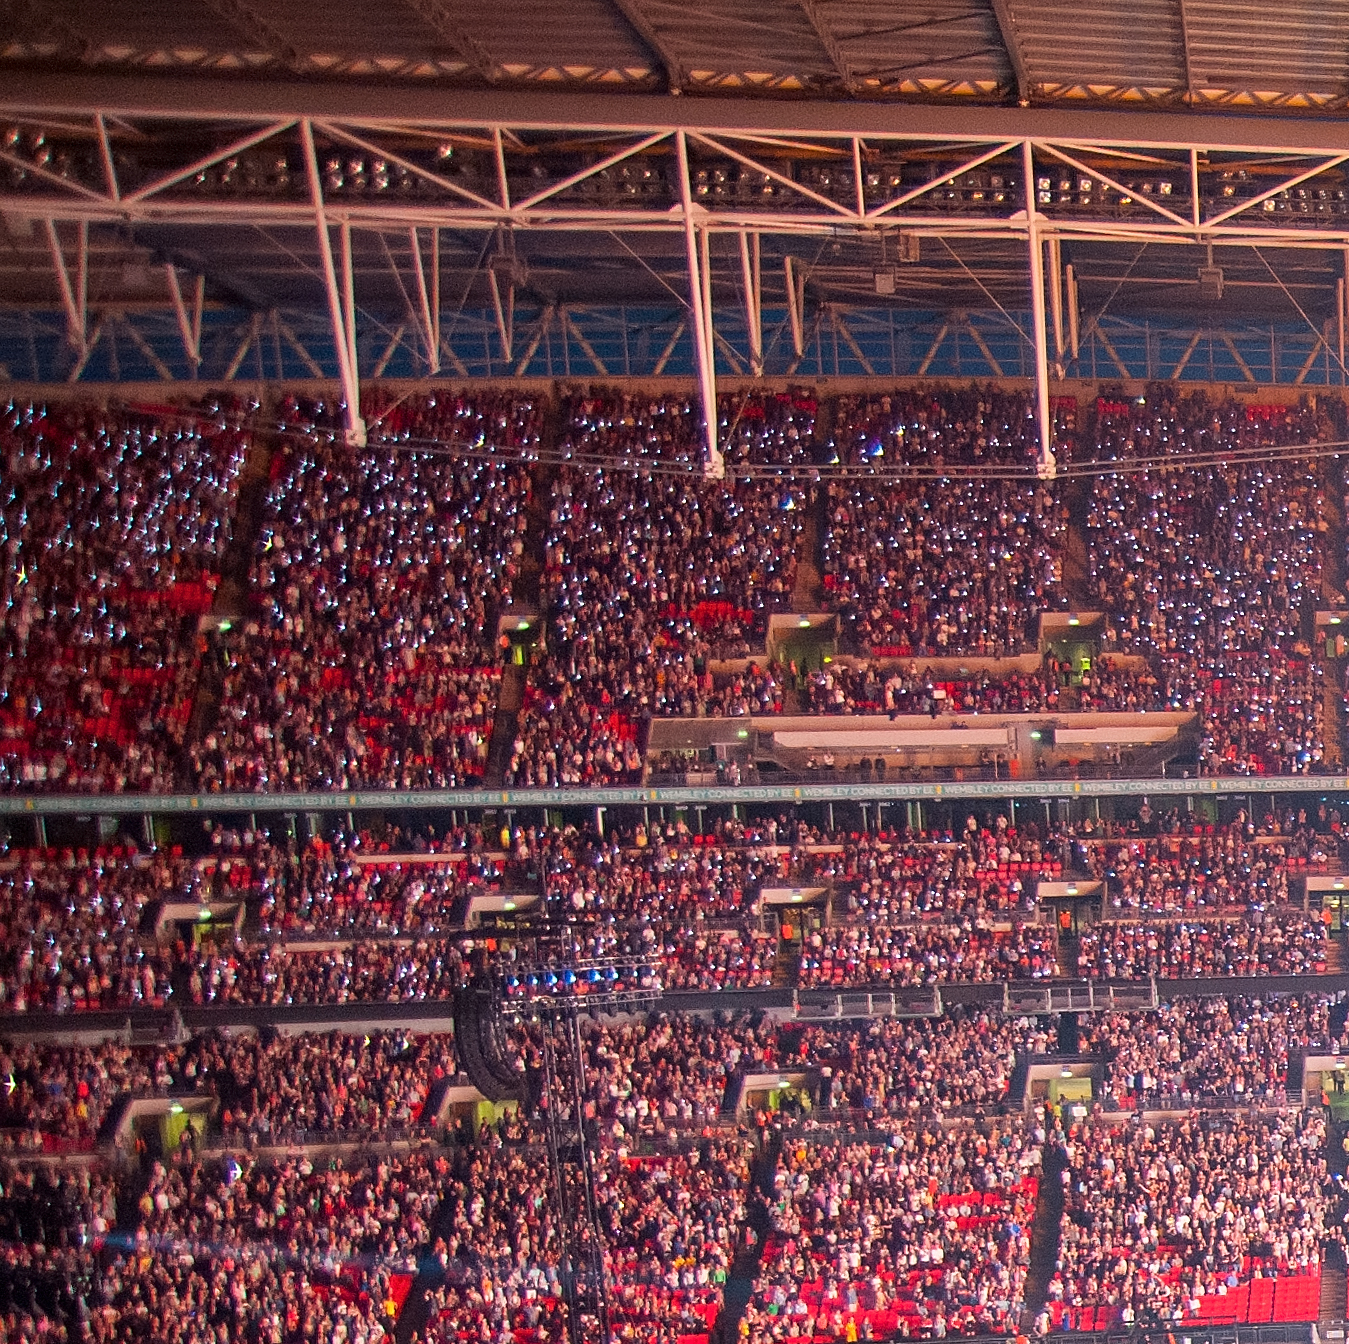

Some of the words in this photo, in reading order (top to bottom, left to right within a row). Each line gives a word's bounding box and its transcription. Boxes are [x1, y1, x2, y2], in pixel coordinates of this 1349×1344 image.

[944, 785, 991, 794] WEMBLEY
[992, 784, 1047, 792] CONNECTED
[1084, 783, 1128, 791] WEMBLEY
[1129, 782, 1183, 791] CONNECTED
[1220, 781, 1264, 789] WEMBLEY
[1265, 780, 1319, 788] CONNECTED
[660, 791, 707, 799] WEMBLEY
[708, 790, 766, 798] CONNECTED
[804, 788, 851, 796] WEMBLEY
[852, 787, 908, 795] CONNECTED
